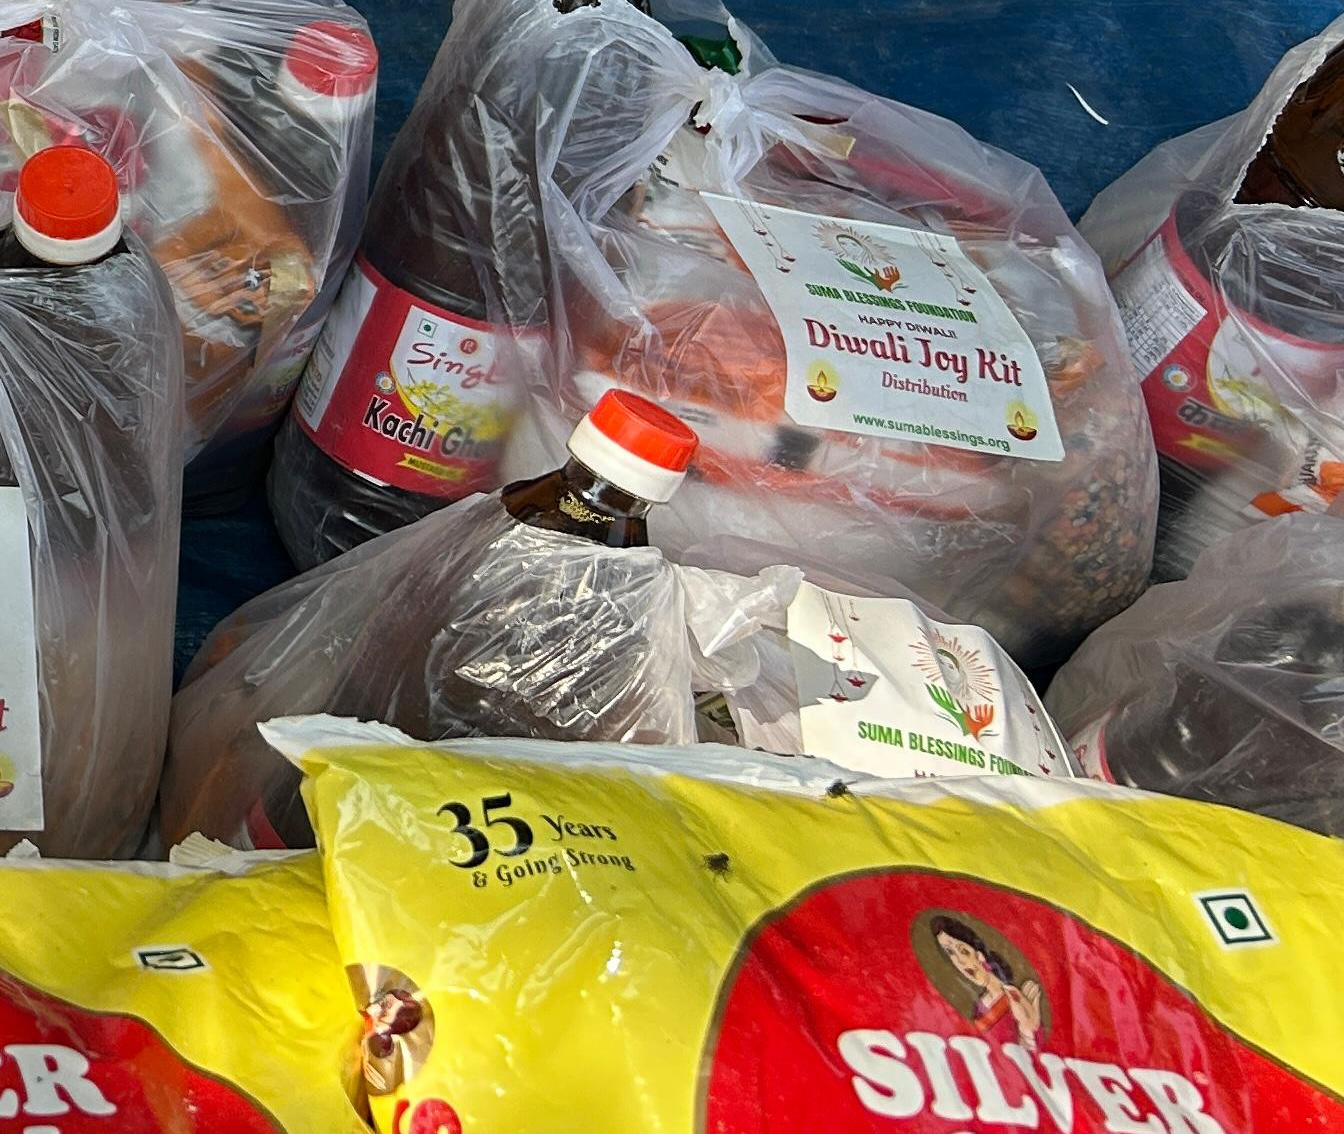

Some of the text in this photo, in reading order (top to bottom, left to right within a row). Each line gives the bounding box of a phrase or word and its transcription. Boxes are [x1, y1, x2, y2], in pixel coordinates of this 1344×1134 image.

[805, 283, 978, 323] SUMA BLESSINGS FOUNDATION
[802, 318, 1023, 386] Diwali Joy Kit
[882, 371, 968, 402] Distribution
[363, 394, 440, 450] Kachi
[853, 414, 1011, 452] www.sumablessings.org
[858, 721, 904, 748] SUMA
[909, 732, 985, 769] BLESSINGS
[437, 792, 618, 868] 35 Years
[471, 847, 636, 888] & Going Strong
[837, 1028, 1225, 1134] SILVER
